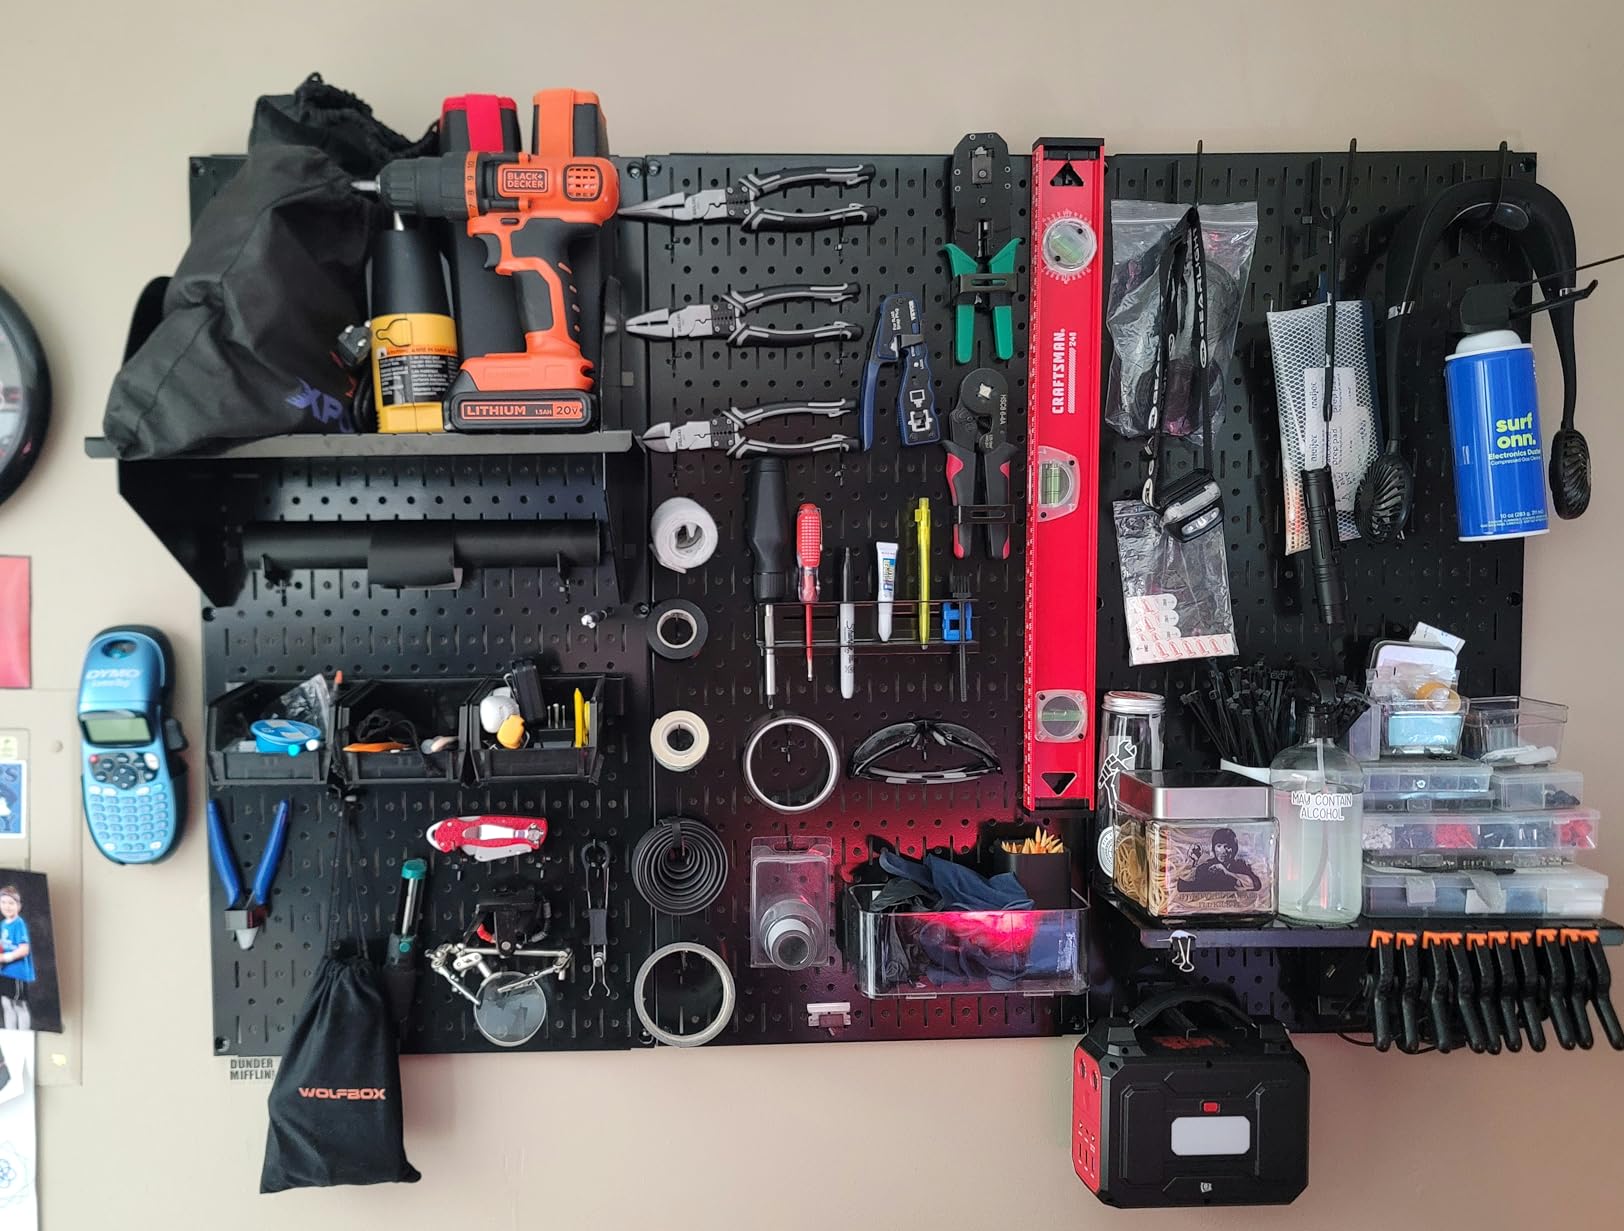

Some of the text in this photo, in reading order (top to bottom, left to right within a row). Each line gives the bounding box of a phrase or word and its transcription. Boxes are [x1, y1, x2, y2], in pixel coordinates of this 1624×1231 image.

[507, 180, 544, 189] DECKER
[466, 405, 527, 416] LITHIUM
[556, 405, 578, 415] 20V
[1496, 412, 1533, 433] surf
[1488, 449, 1527, 460] Electronics
[86, 668, 141, 680] DYMO
[1292, 791, 1352, 806] MAY CONTAIN
[1301, 807, 1344, 820] ALCOHOL
[230, 1058, 273, 1069] DUNDER
[298, 1087, 387, 1100] WOLFBOX
